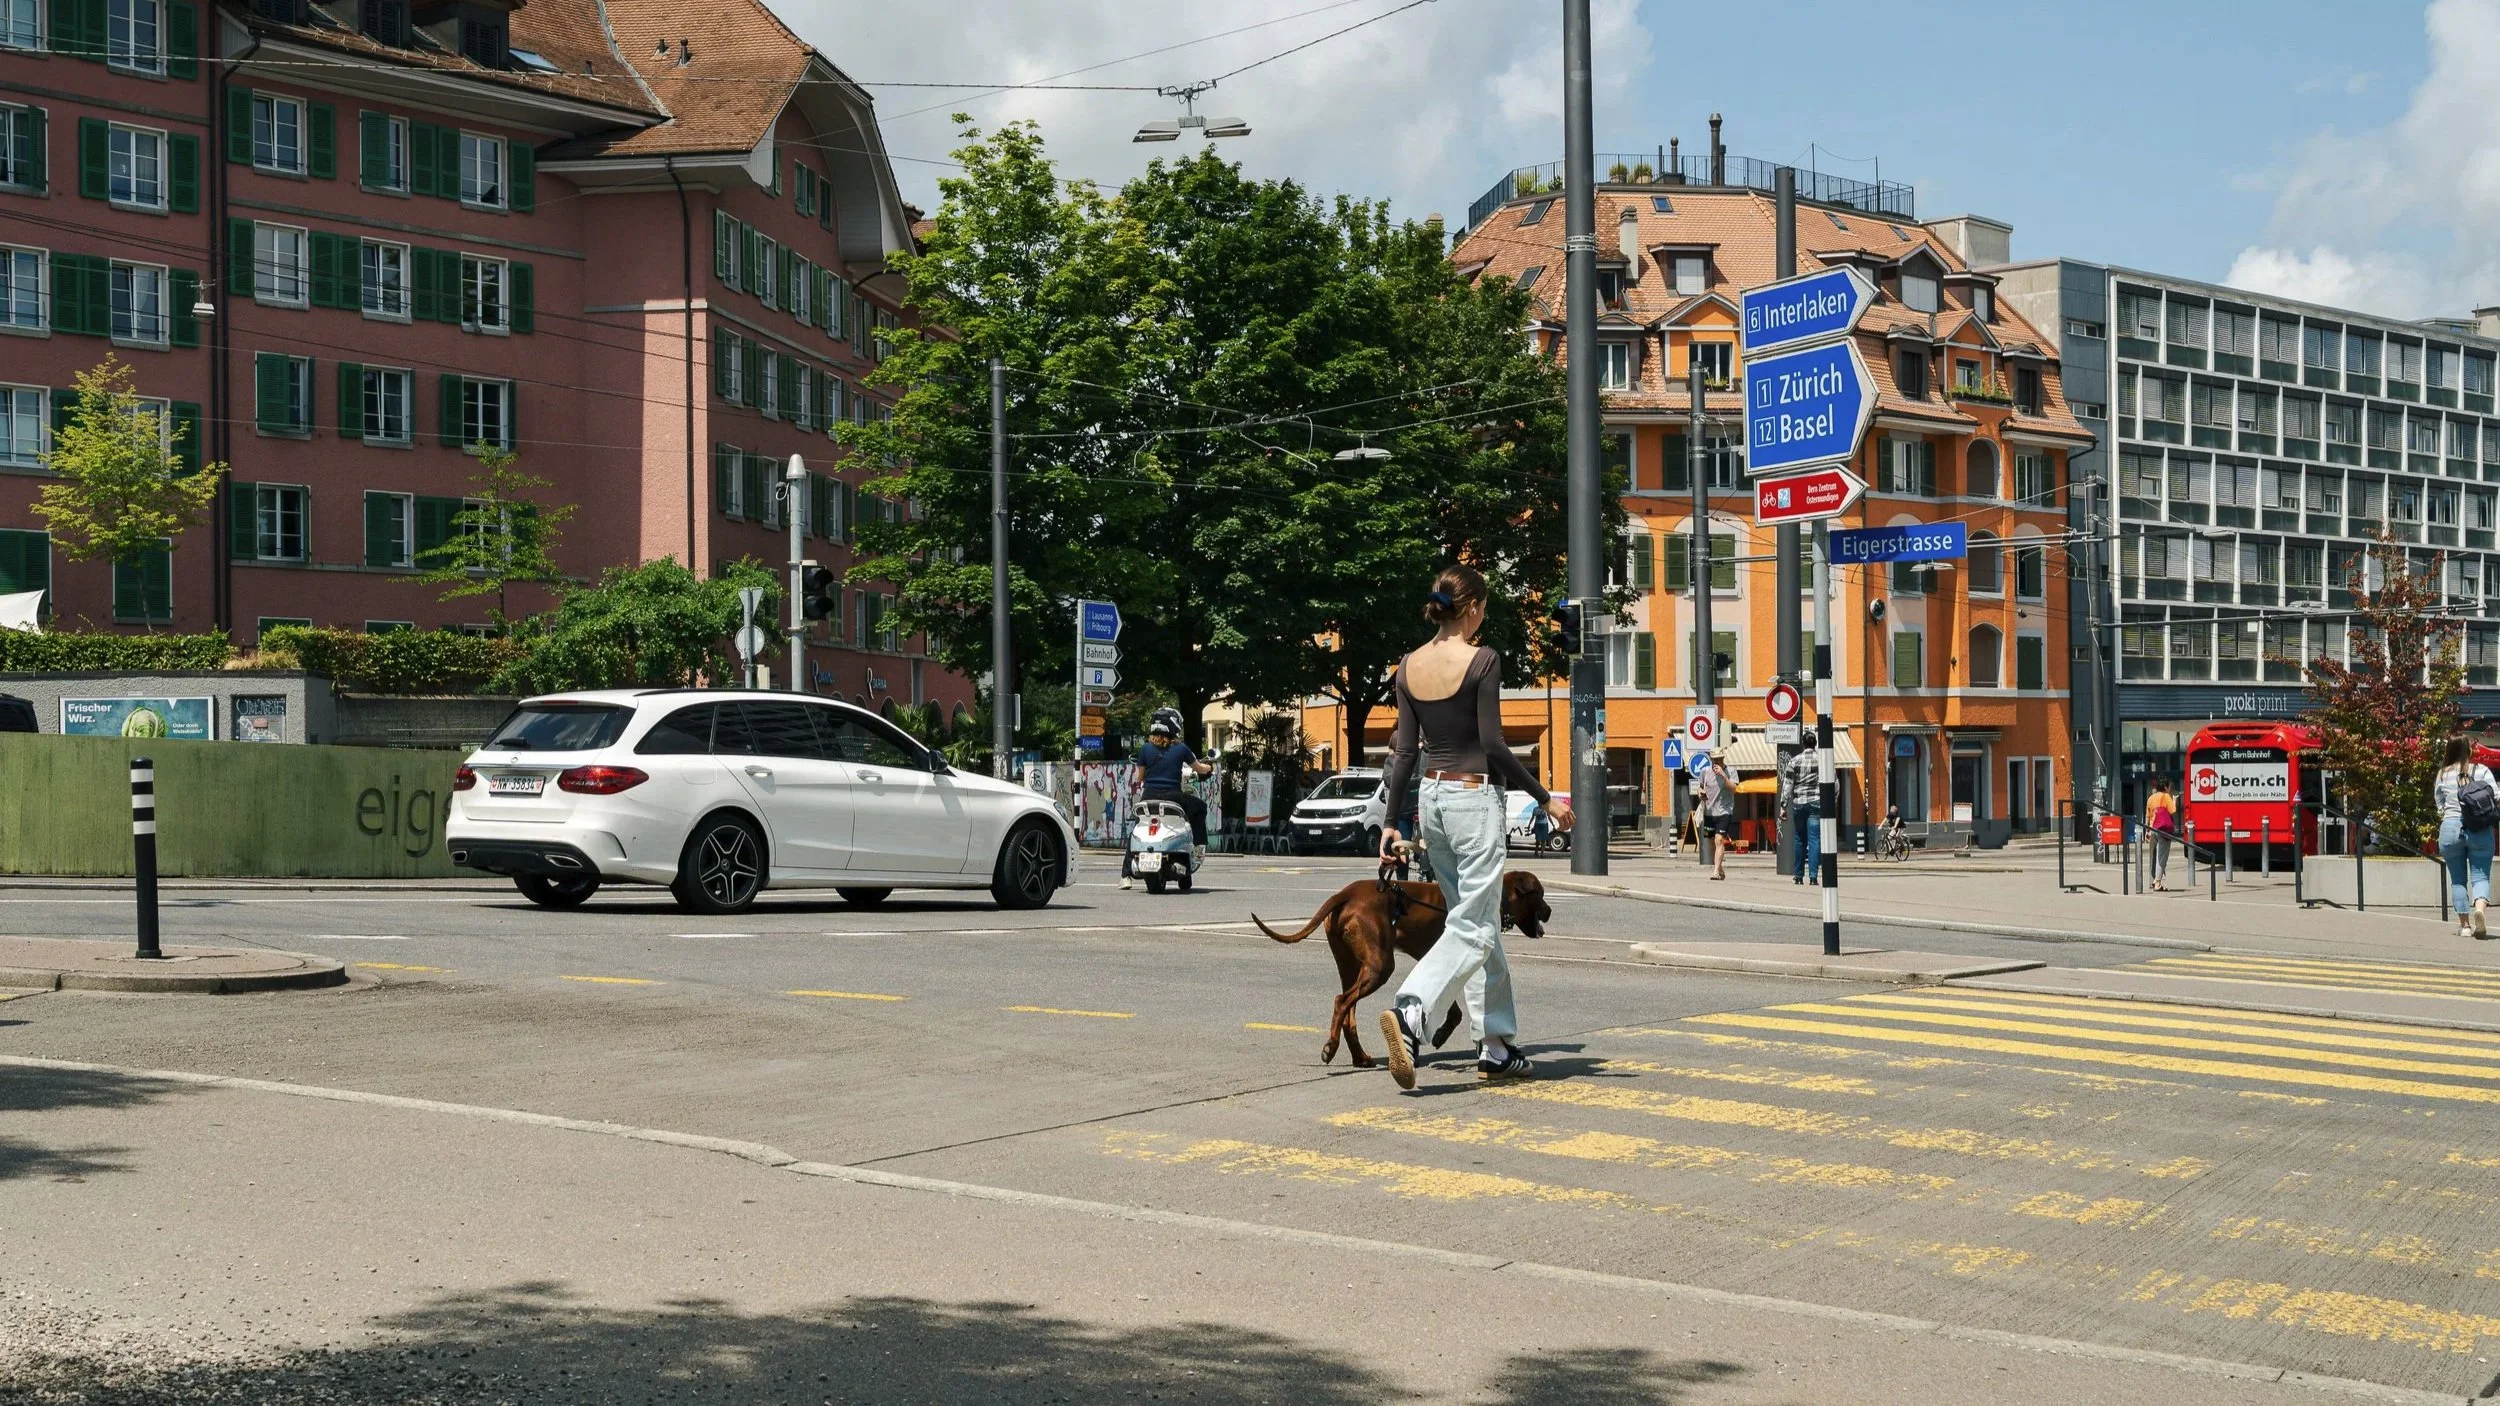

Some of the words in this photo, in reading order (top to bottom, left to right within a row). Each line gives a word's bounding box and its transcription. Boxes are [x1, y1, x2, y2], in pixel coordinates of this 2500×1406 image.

[1750, 311, 1758, 328] 6
[1765, 289, 1847, 329] Interlaken
[1761, 383, 1767, 403] 1
[1780, 362, 1843, 404] Zürich
[1759, 421, 1772, 442] 12
[1780, 403, 1834, 443] Basel
[1807, 484, 1818, 494] Bern
[1818, 482, 1837, 493] Zentrum
[1806, 493, 1839, 505] Ostermundigen
[1842, 534, 1953, 560] Eigerstrasse
[1091, 610, 1114, 623] Lausanne
[1091, 621, 1112, 635] Fribourg
[1086, 647, 1113, 660] Bahnhof
[68, 703, 112, 712] Frischer
[2224, 691, 2256, 716] proki
[2257, 692, 2288, 716] print
[68, 713, 96, 723] Wirz.
[1695, 723, 1706, 733] 30
[2233, 750, 2246, 758] Bern
[2247, 750, 2271, 759] Bahnhof
[497, 778, 510, 790] NW
[511, 778, 536, 790] 35834
